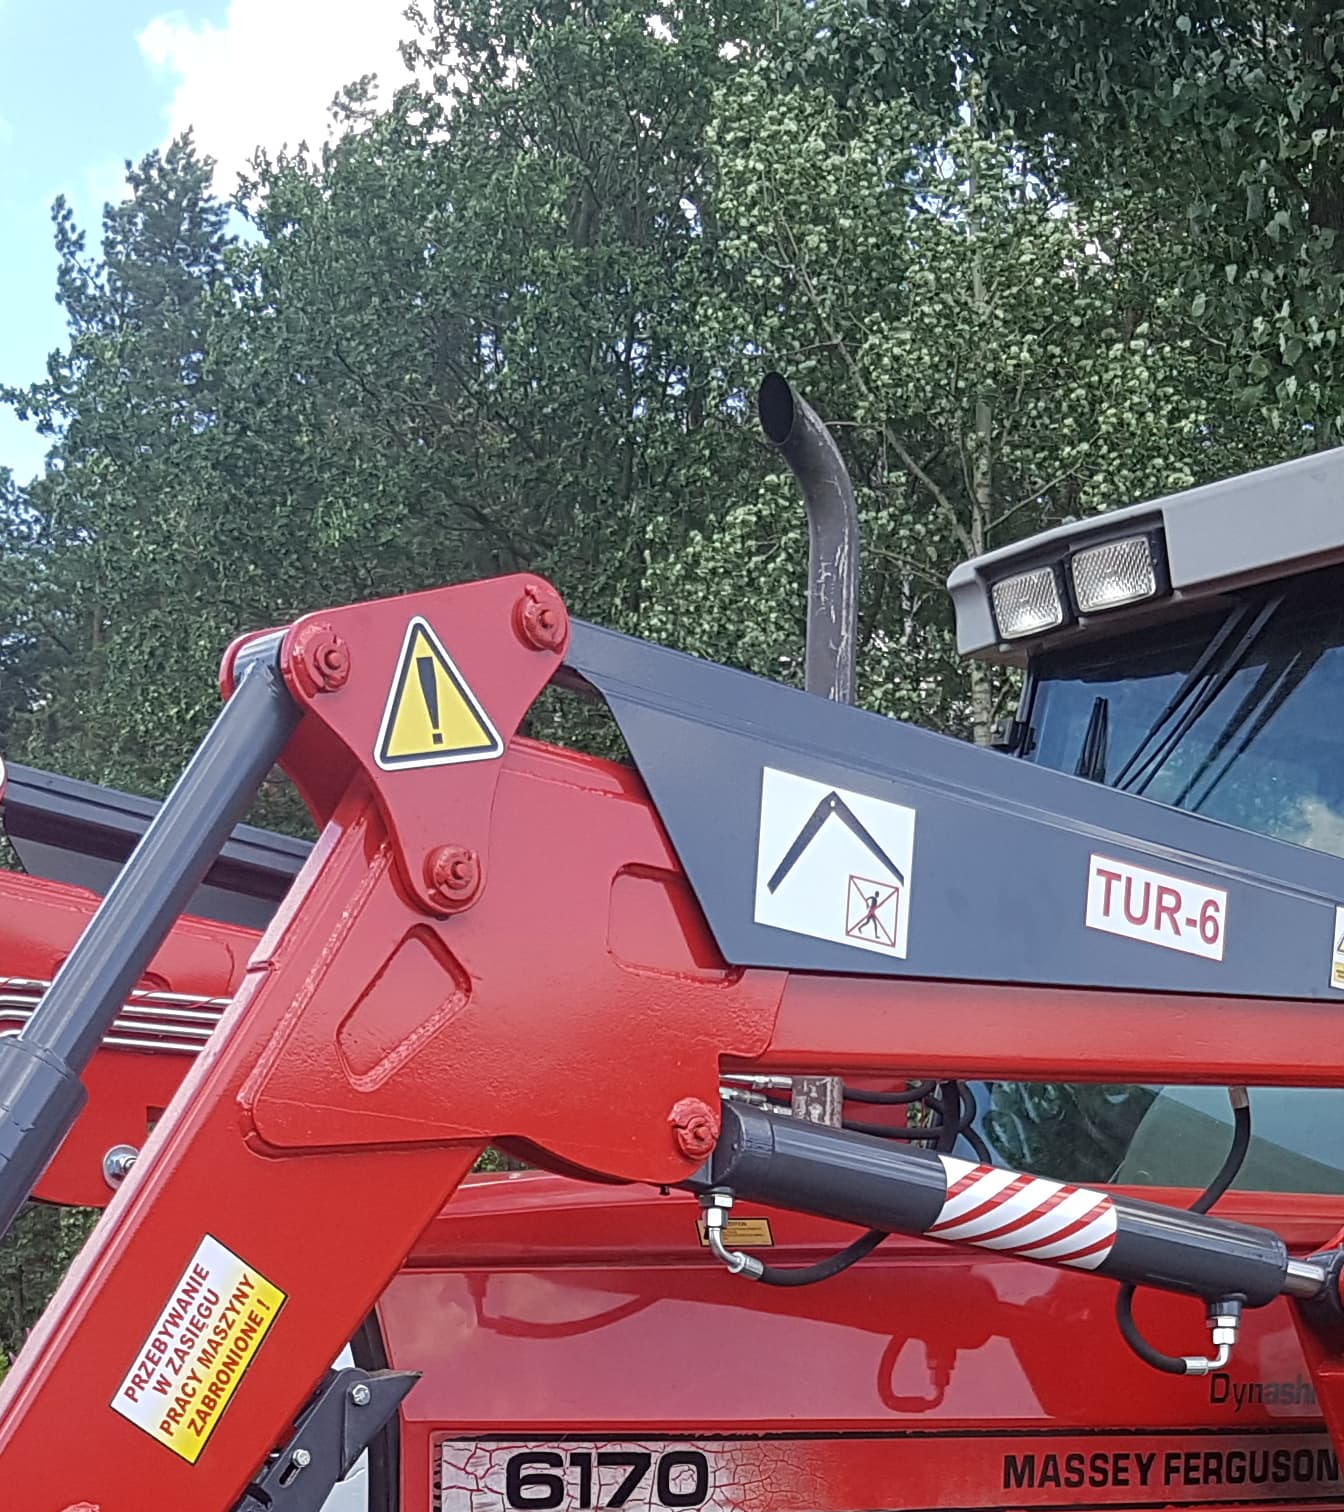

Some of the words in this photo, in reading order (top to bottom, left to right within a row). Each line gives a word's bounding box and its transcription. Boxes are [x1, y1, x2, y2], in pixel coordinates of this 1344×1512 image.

[1096, 867, 1220, 945] TUR-6
[123, 1262, 210, 1404] PRZEBYWANIE
[159, 1367, 204, 1437] PRACY
[196, 1273, 256, 1370] MASZYNY
[151, 1373, 173, 1397] W
[187, 1309, 265, 1438] ZABRONIONE
[506, 1450, 709, 1510] 6170
[1003, 1453, 1156, 1489] MASSEY
[1164, 1448, 1340, 1486] FERGUSON
